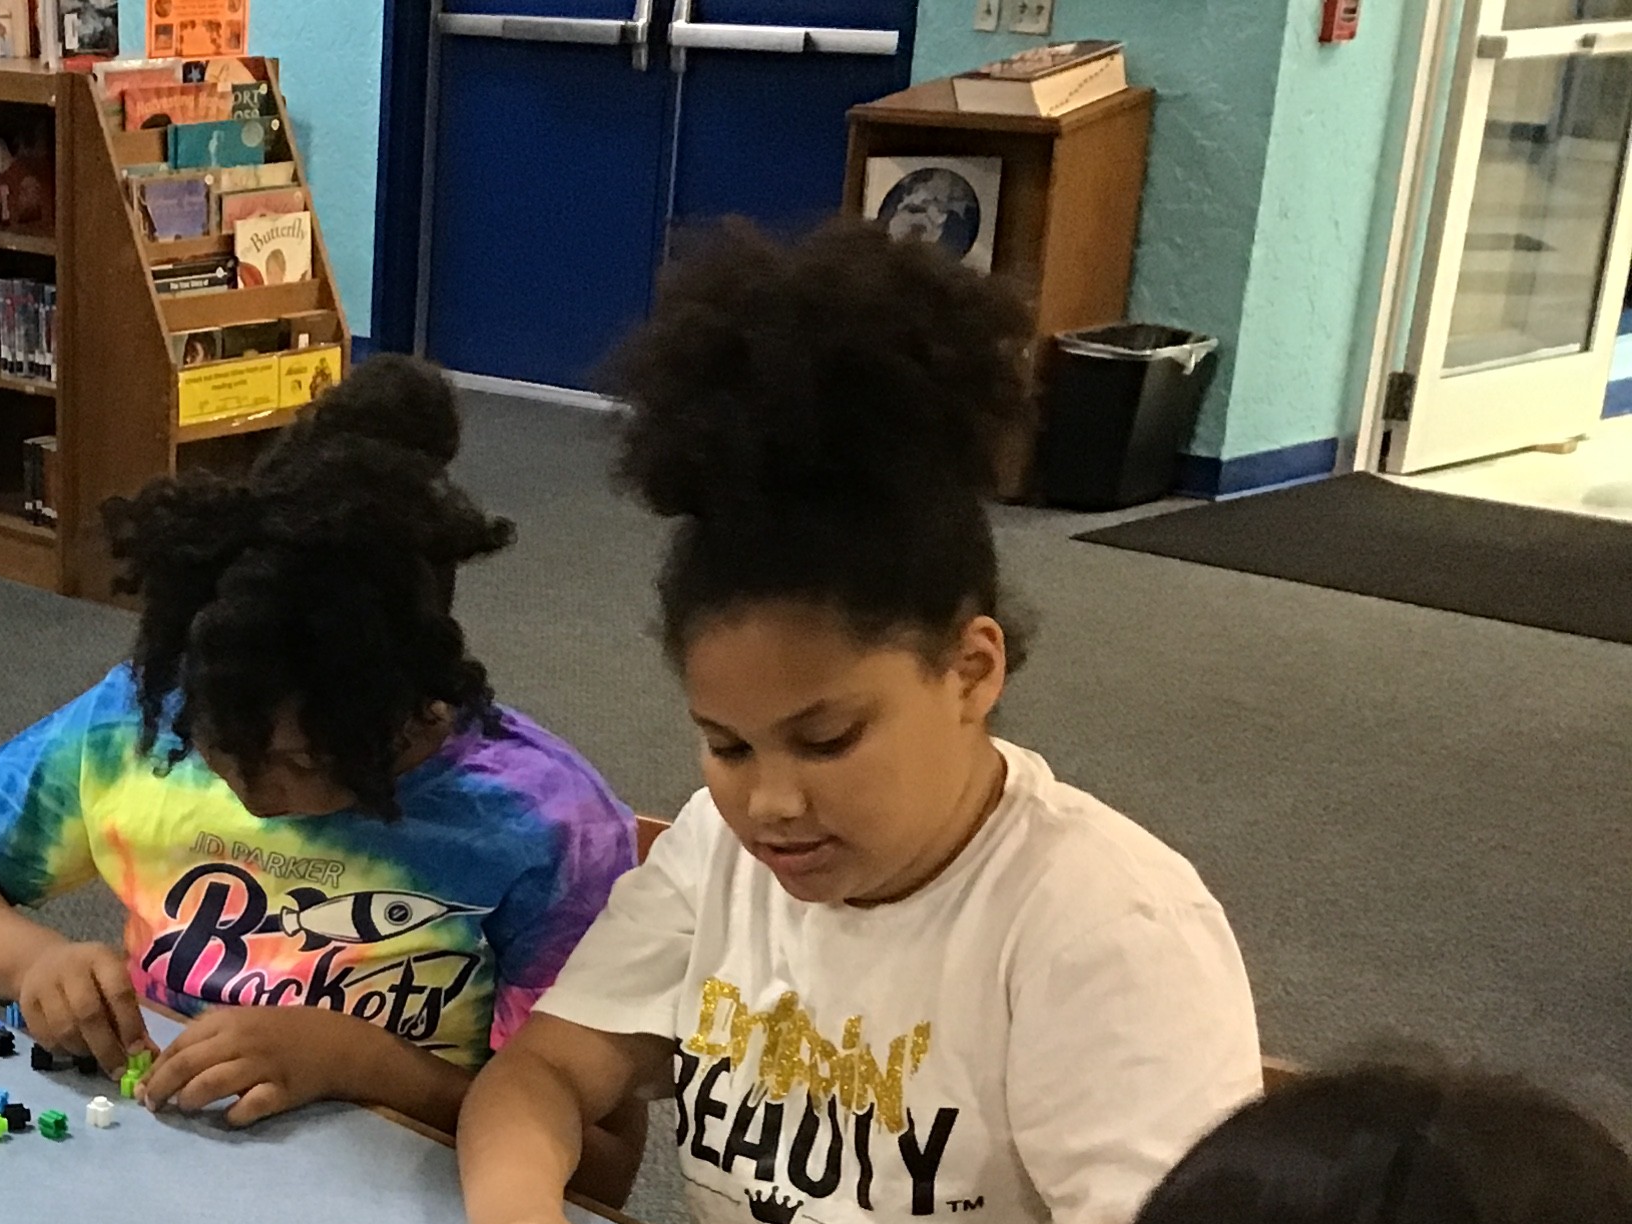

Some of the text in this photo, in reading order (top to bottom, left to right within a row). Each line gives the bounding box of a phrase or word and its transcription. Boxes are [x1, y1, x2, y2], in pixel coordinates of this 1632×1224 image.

[250, 217, 307, 253] Butterfly
[189, 830, 347, 889] JD PARKER
